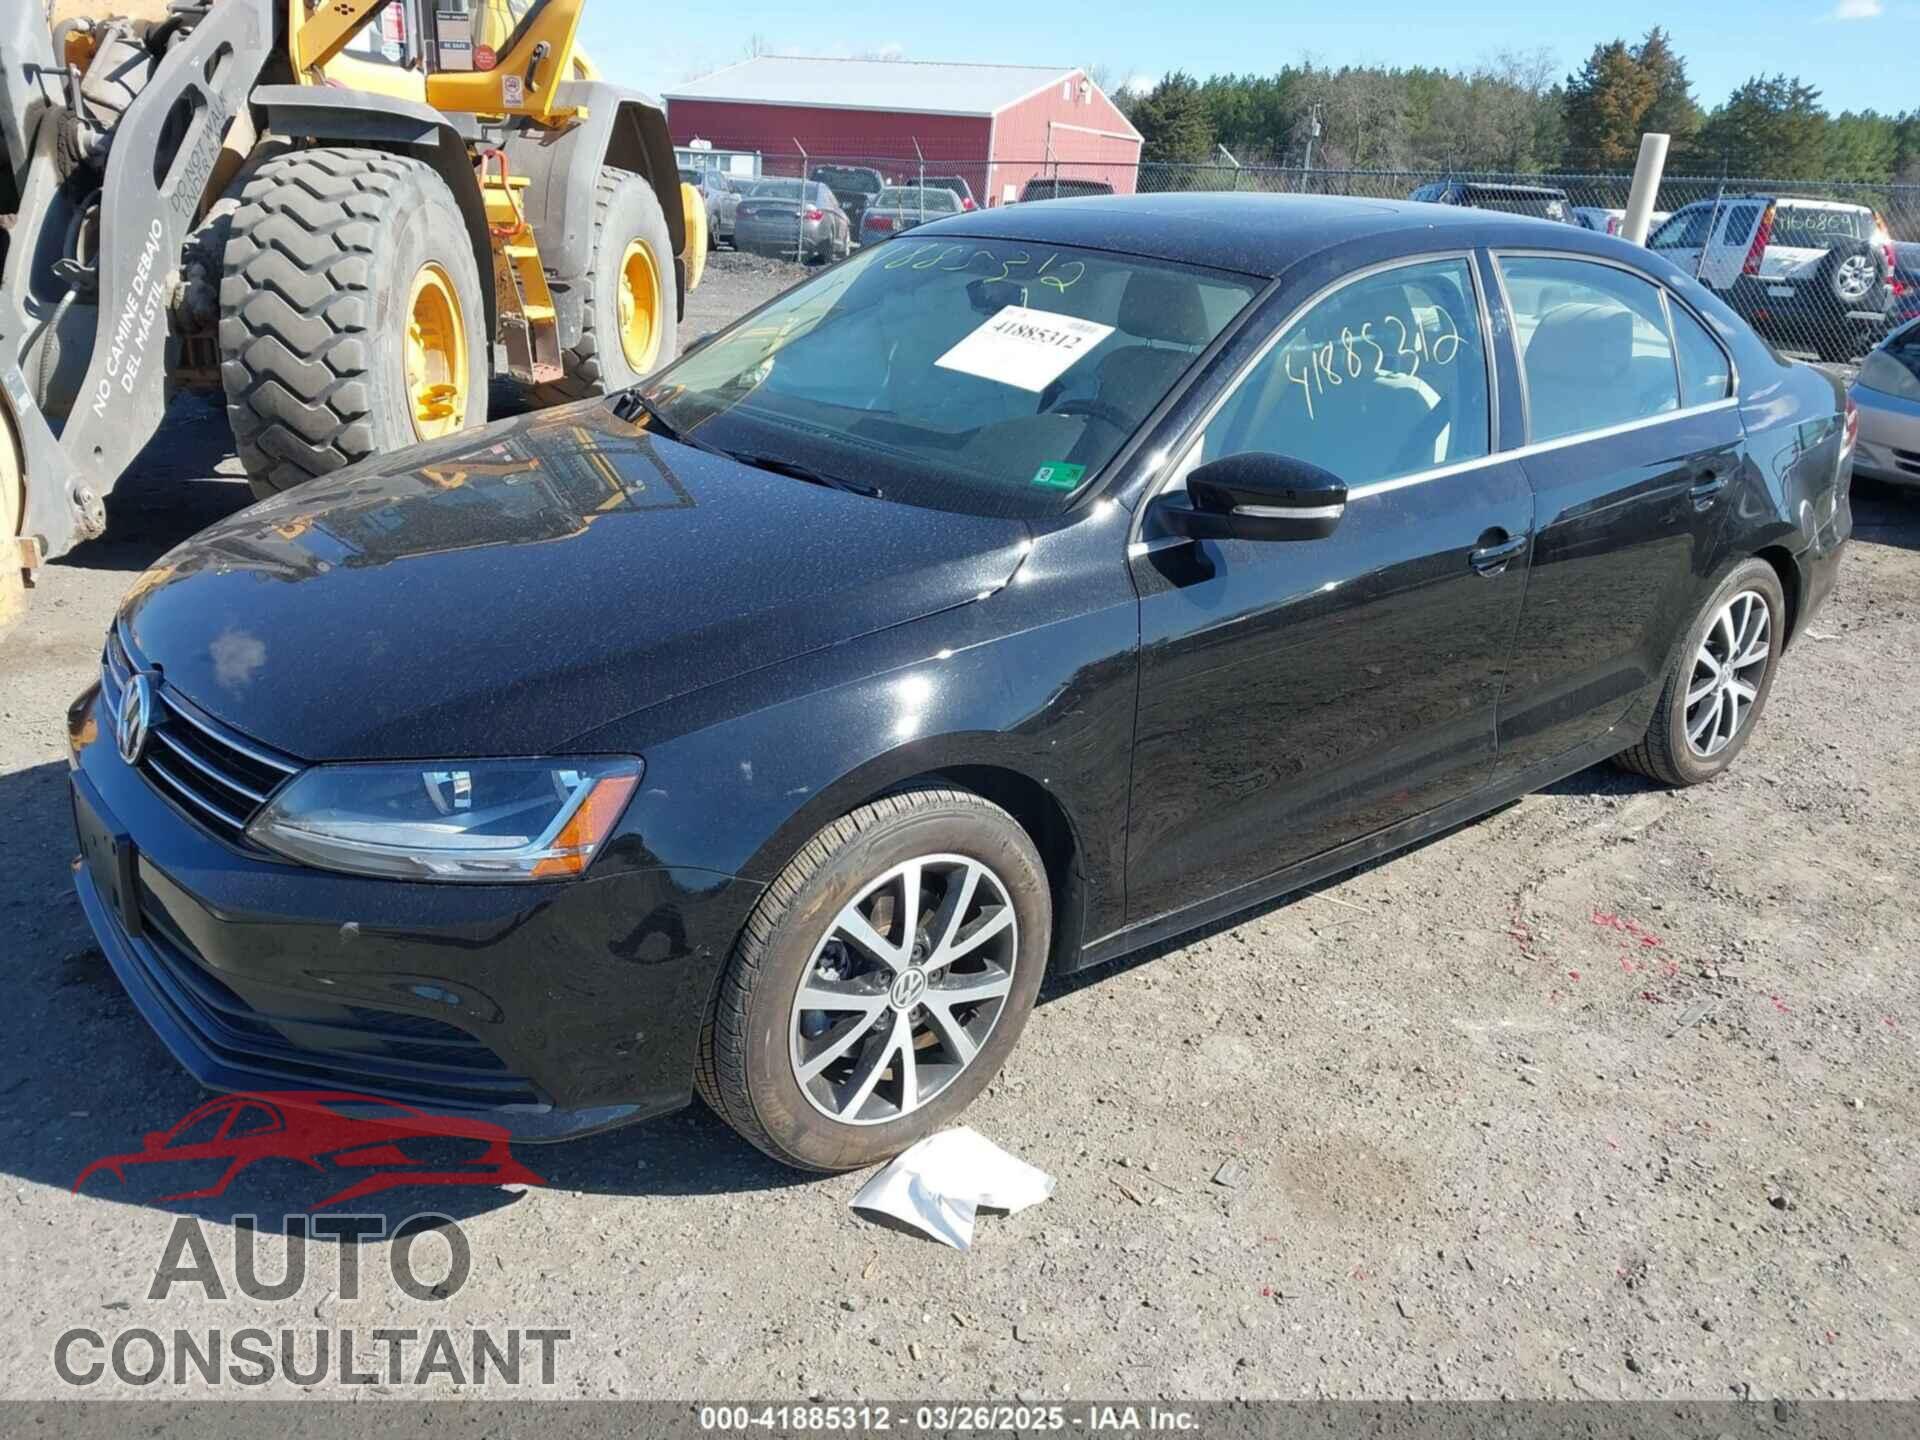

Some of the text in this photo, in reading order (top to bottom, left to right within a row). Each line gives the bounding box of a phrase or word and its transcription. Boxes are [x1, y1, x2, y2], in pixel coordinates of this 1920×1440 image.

[171, 179, 186, 213] DO
[184, 137, 205, 181] NOT
[92, 218, 163, 418] NO CAMINE DEBAJO
[121, 280, 165, 394] DEL MÁSTIL
[993, 320, 1083, 350] 41885312
